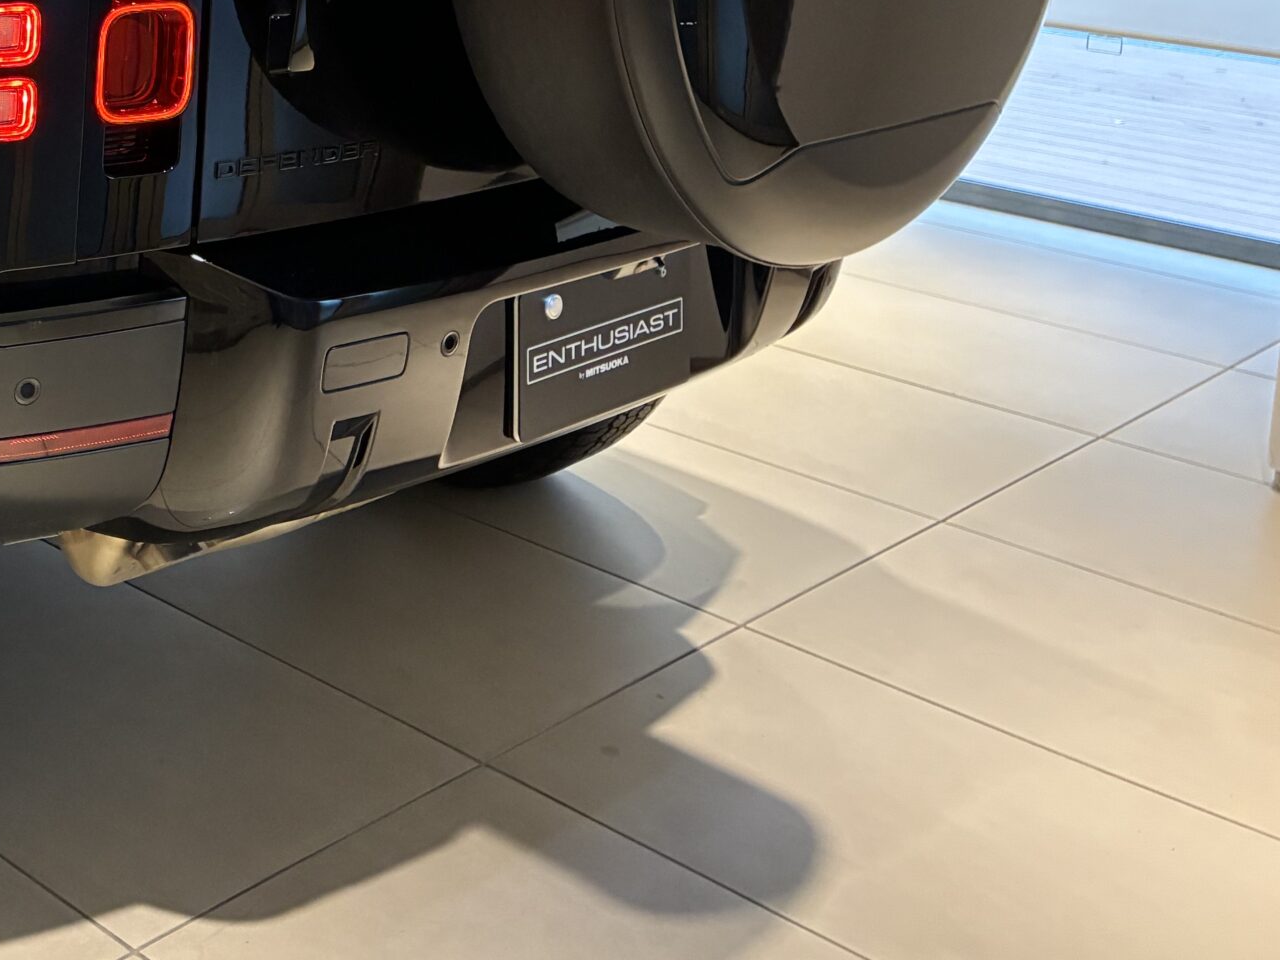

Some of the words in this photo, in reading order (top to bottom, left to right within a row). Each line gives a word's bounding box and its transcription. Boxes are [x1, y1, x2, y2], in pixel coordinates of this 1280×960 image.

[213, 140, 379, 180] DEFENDER
[532, 308, 678, 374] ENTHUSIAST
[585, 355, 629, 379] MITSUOKA
